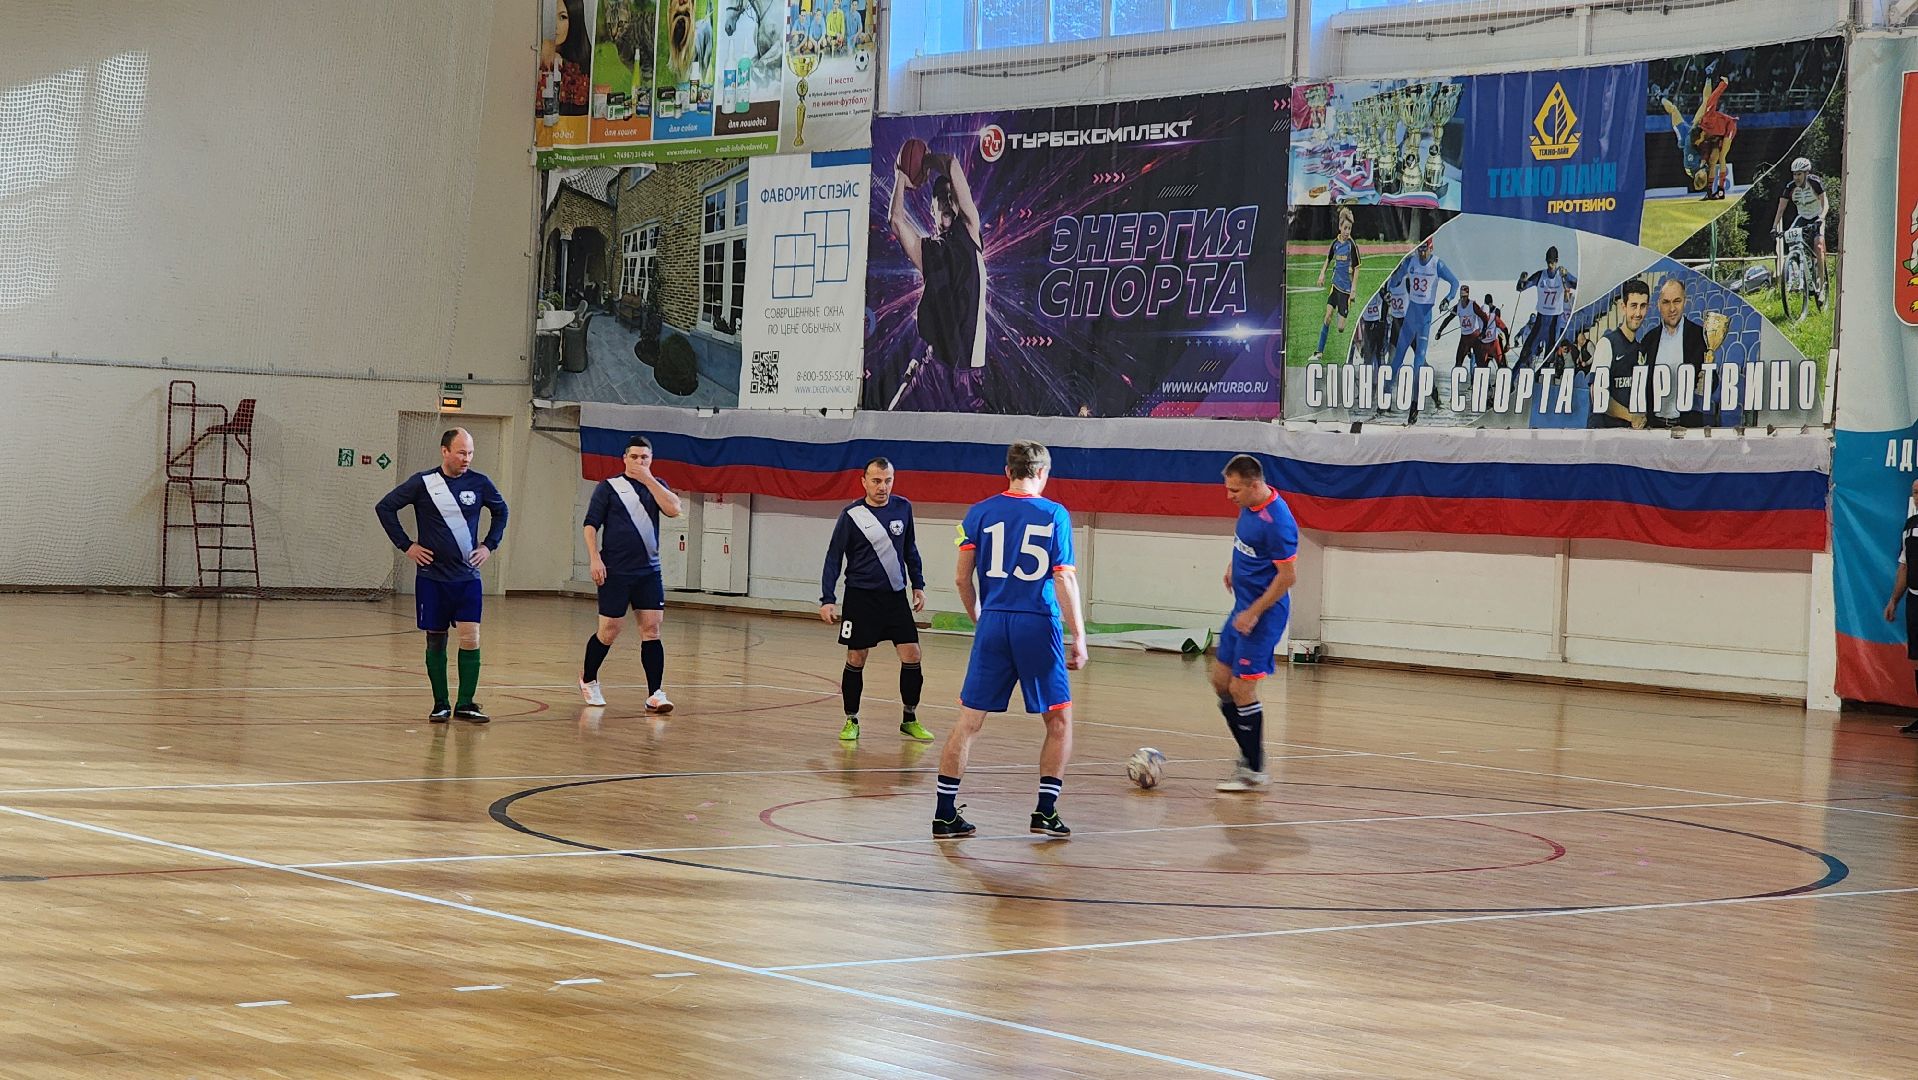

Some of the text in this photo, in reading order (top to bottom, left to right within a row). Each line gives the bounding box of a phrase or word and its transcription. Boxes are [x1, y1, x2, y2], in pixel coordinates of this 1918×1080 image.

[821, 96, 868, 107] мини-футболу
[739, 116, 767, 128] лошадей
[1007, 120, 1193, 150] ТУРБОКОМПЛЕКТ
[1487, 157, 1617, 199] ТЕХНО ЛАЙН
[760, 180, 860, 203] ФАВОРИТ СПЭЙС
[1547, 197, 1616, 214] ПРОТВИНО
[1049, 205, 1259, 264] ЭНЕРГИЯ
[1038, 262, 1247, 317] СПОРТА
[1413, 277, 1428, 292] 83
[1543, 290, 1557, 306] 77
[764, 305, 845, 319] СОВЕРШЕННЫЕ ОКНА
[767, 322, 841, 336] ПО ЦЕНЕ ОБЫЧНЫХ
[1161, 381, 1269, 393] WWW.KAMTURBO.RU
[1305, 359, 1818, 414] СПОНСОР СПОРТА В ПРОТВИНО
[1614, 376, 1632, 389] ТЕХН
[1885, 438, 1918, 472] АД
[983, 521, 1054, 582] 15
[841, 620, 853, 639] 8
